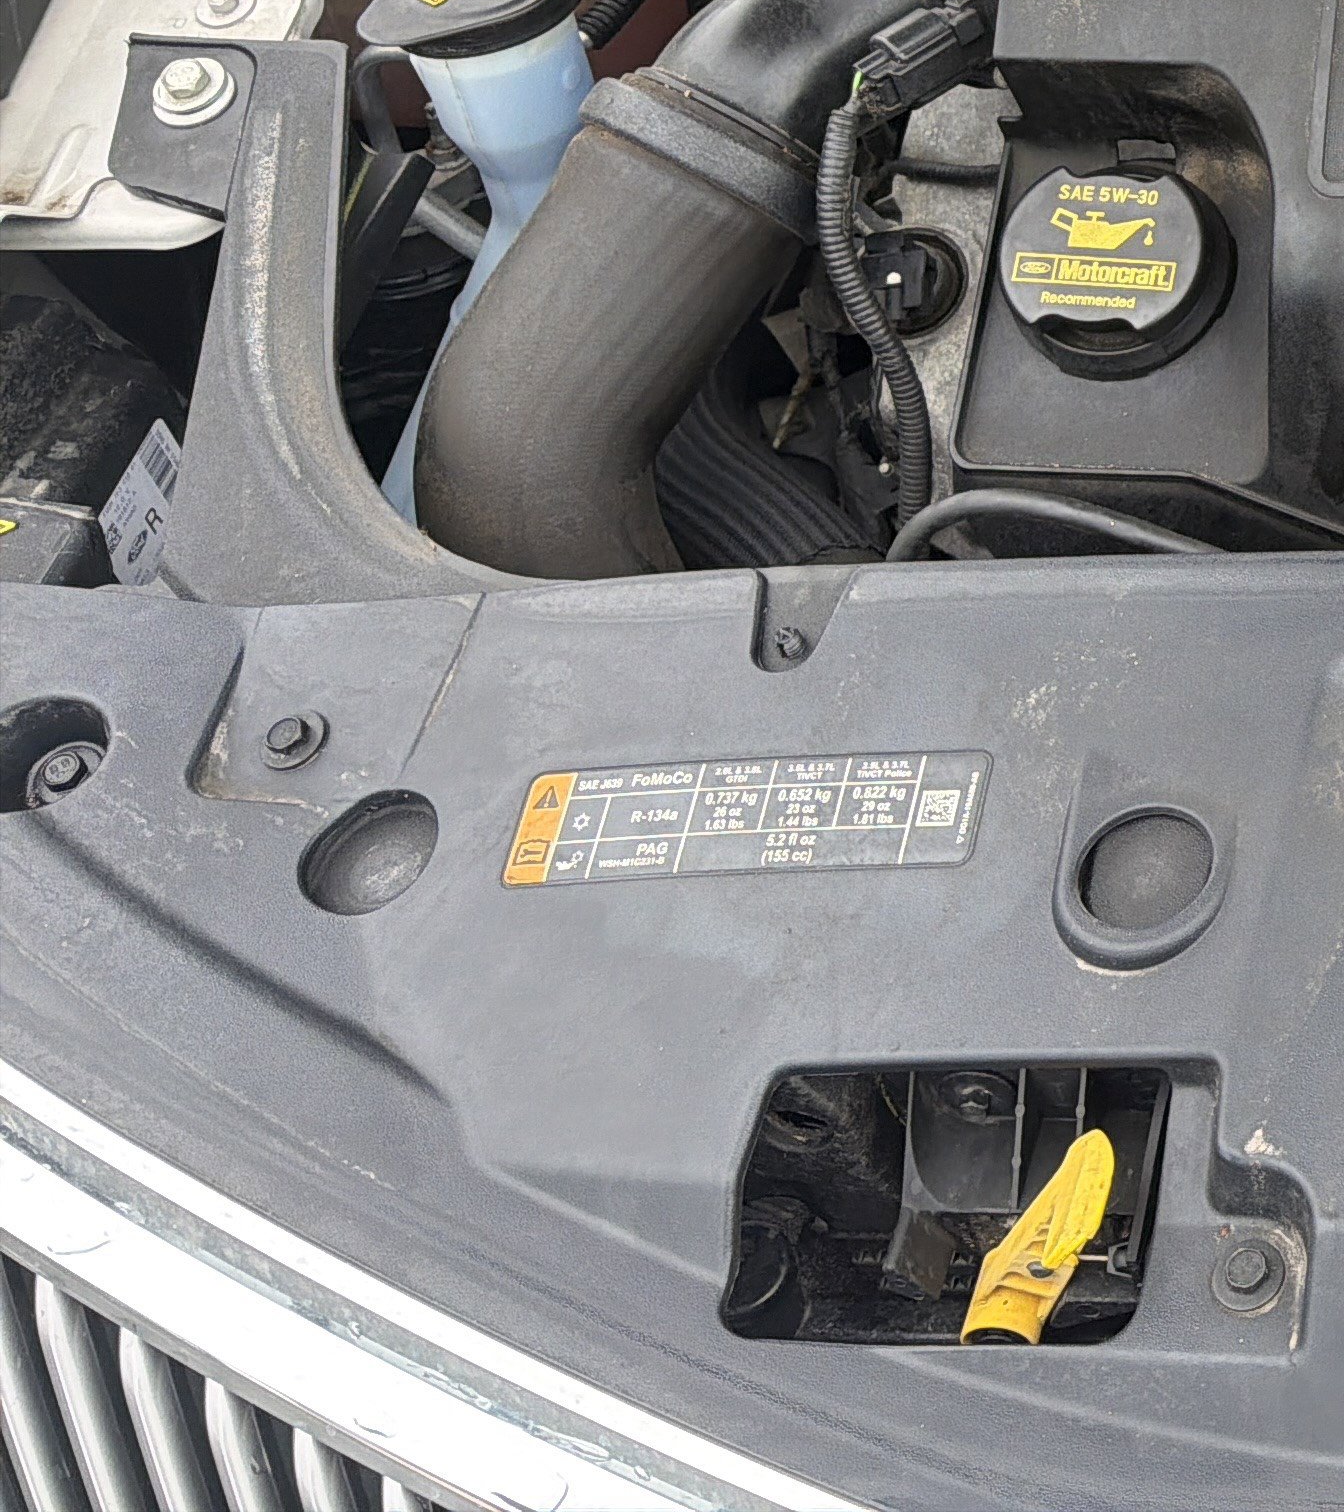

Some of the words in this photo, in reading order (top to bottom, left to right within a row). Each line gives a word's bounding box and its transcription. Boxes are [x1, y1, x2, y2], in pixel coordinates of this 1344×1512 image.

[1058, 184, 1095, 202] SAE
[1099, 186, 1159, 206] 5W-30
[1058, 258, 1169, 287] Motorcraft
[1040, 291, 1137, 309] Recommended
[145, 507, 163, 535] R
[578, 779, 599, 792] SAE
[631, 771, 693, 787] FoMoCo
[705, 791, 740, 806] 0.737
[741, 790, 759, 806] kg
[777, 788, 813, 802] 0.652
[814, 787, 832, 803] kg
[852, 786, 888, 800] 0.822
[889, 785, 907, 801] kg
[712, 806, 727, 818] 26
[728, 807, 743, 817] oz
[785, 803, 800, 815] 23
[801, 804, 817, 814] oz
[860, 800, 876, 812] 29
[877, 801, 892, 811] oz
[631, 809, 679, 823] R-134a
[778, 816, 800, 827] 1.44
[801, 815, 819, 826] lbs
[876, 813, 894, 824] lbs
[704, 819, 726, 831] 1.63
[727, 818, 745, 829] lbs
[765, 833, 787, 847] 5.2
[788, 833, 798, 846] fl
[799, 834, 818, 846] oz
[636, 842, 669, 856] PAG
[761, 848, 790, 867] (155
[791, 847, 813, 865] cc)
